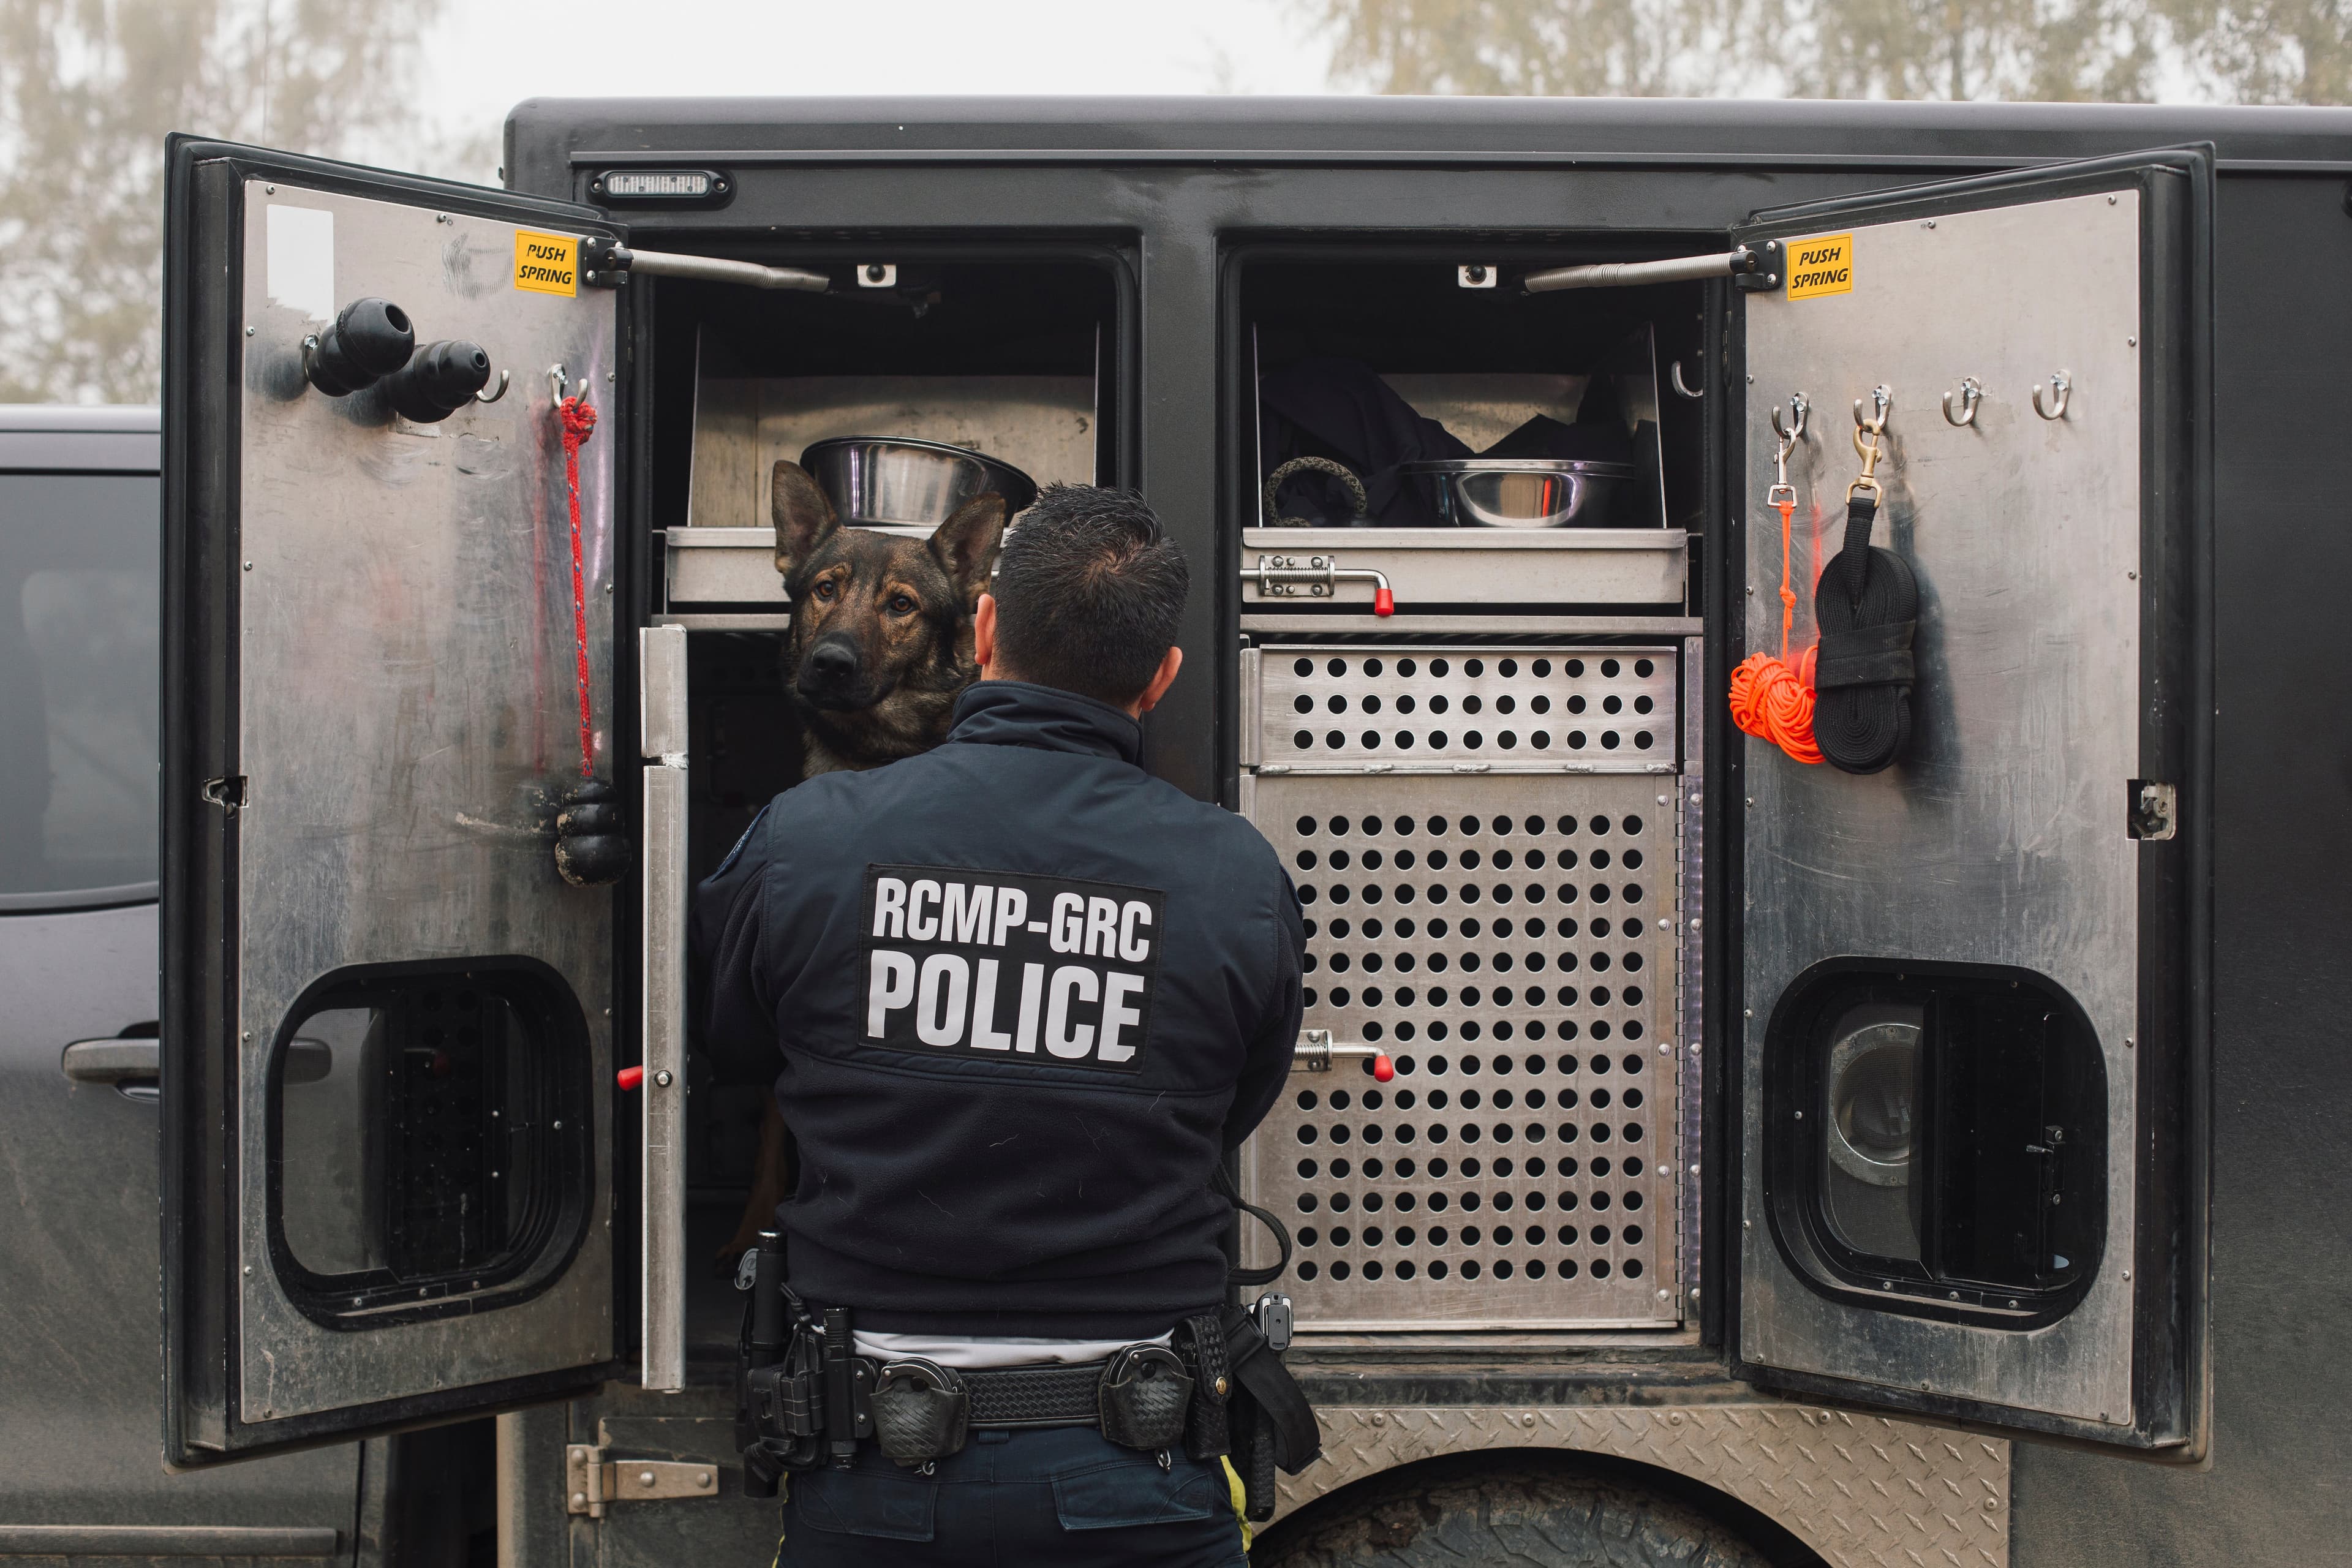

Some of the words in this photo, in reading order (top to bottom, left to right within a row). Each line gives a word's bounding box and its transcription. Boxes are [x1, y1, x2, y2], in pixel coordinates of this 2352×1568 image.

[527, 244, 566, 262] PUSH
[1799, 247, 1841, 266] PUSH
[519, 265, 572, 284] SPRING
[1792, 268, 1849, 288] SPRING
[873, 877, 1152, 962] RCMP-GRC
[867, 949, 1145, 1062] POLICE
